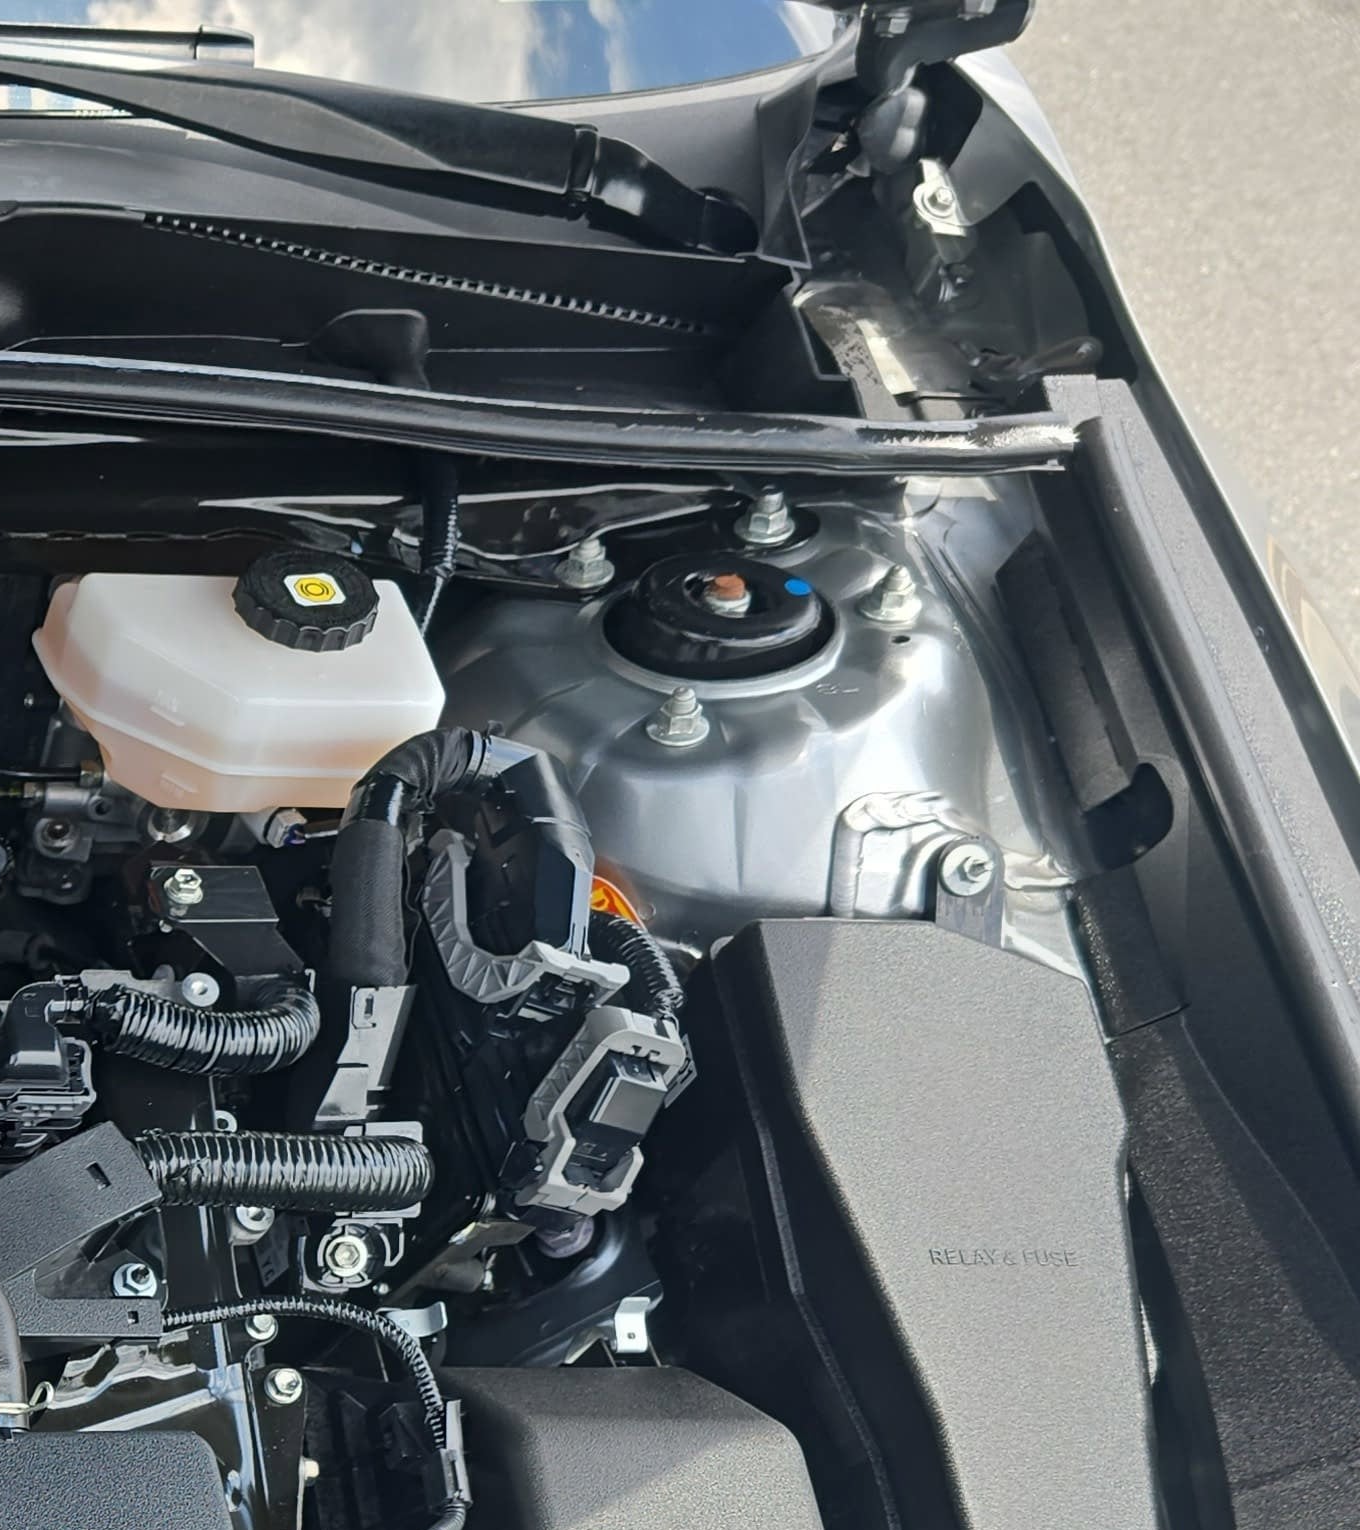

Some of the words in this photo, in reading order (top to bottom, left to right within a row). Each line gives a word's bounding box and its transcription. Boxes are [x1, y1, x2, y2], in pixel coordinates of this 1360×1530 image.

[929, 1248, 997, 1266] RELAY
[1003, 1251, 1016, 1266] &
[1022, 1249, 1079, 1267] FUSE
